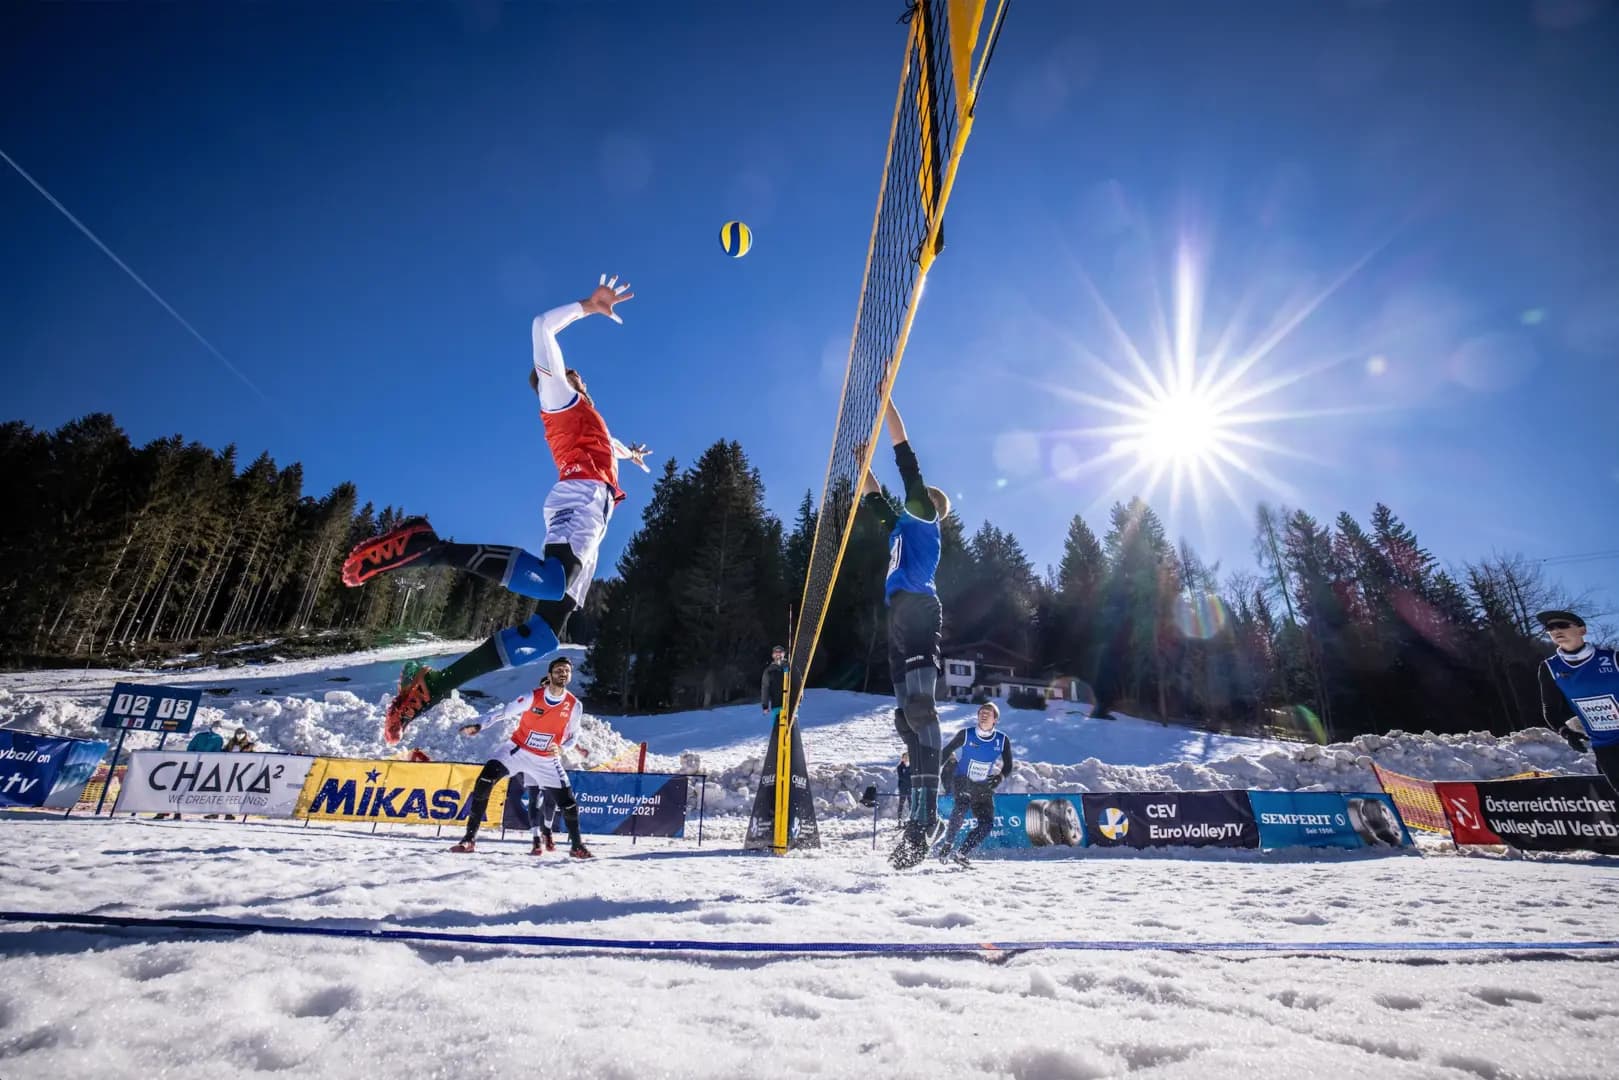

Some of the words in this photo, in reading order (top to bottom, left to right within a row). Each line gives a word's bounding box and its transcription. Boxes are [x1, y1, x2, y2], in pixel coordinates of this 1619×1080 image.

[1598, 656, 1612, 666] 2
[119, 695, 149, 712] 12
[162, 699, 191, 715] 13
[37, 754, 52, 764] on
[168, 794, 185, 804] WE
[185, 795, 224, 805] CREATE
[580, 792, 609, 804] Snow
[611, 794, 661, 805] Volleyball
[1485, 795, 1617, 812] Österreichischer
[607, 805, 630, 816] Tour
[632, 806, 656, 817] 2021
[1146, 804, 1177, 818] CEV
[1261, 813, 1332, 825] SEMPERIT
[1489, 819, 1568, 838] Volleyball
